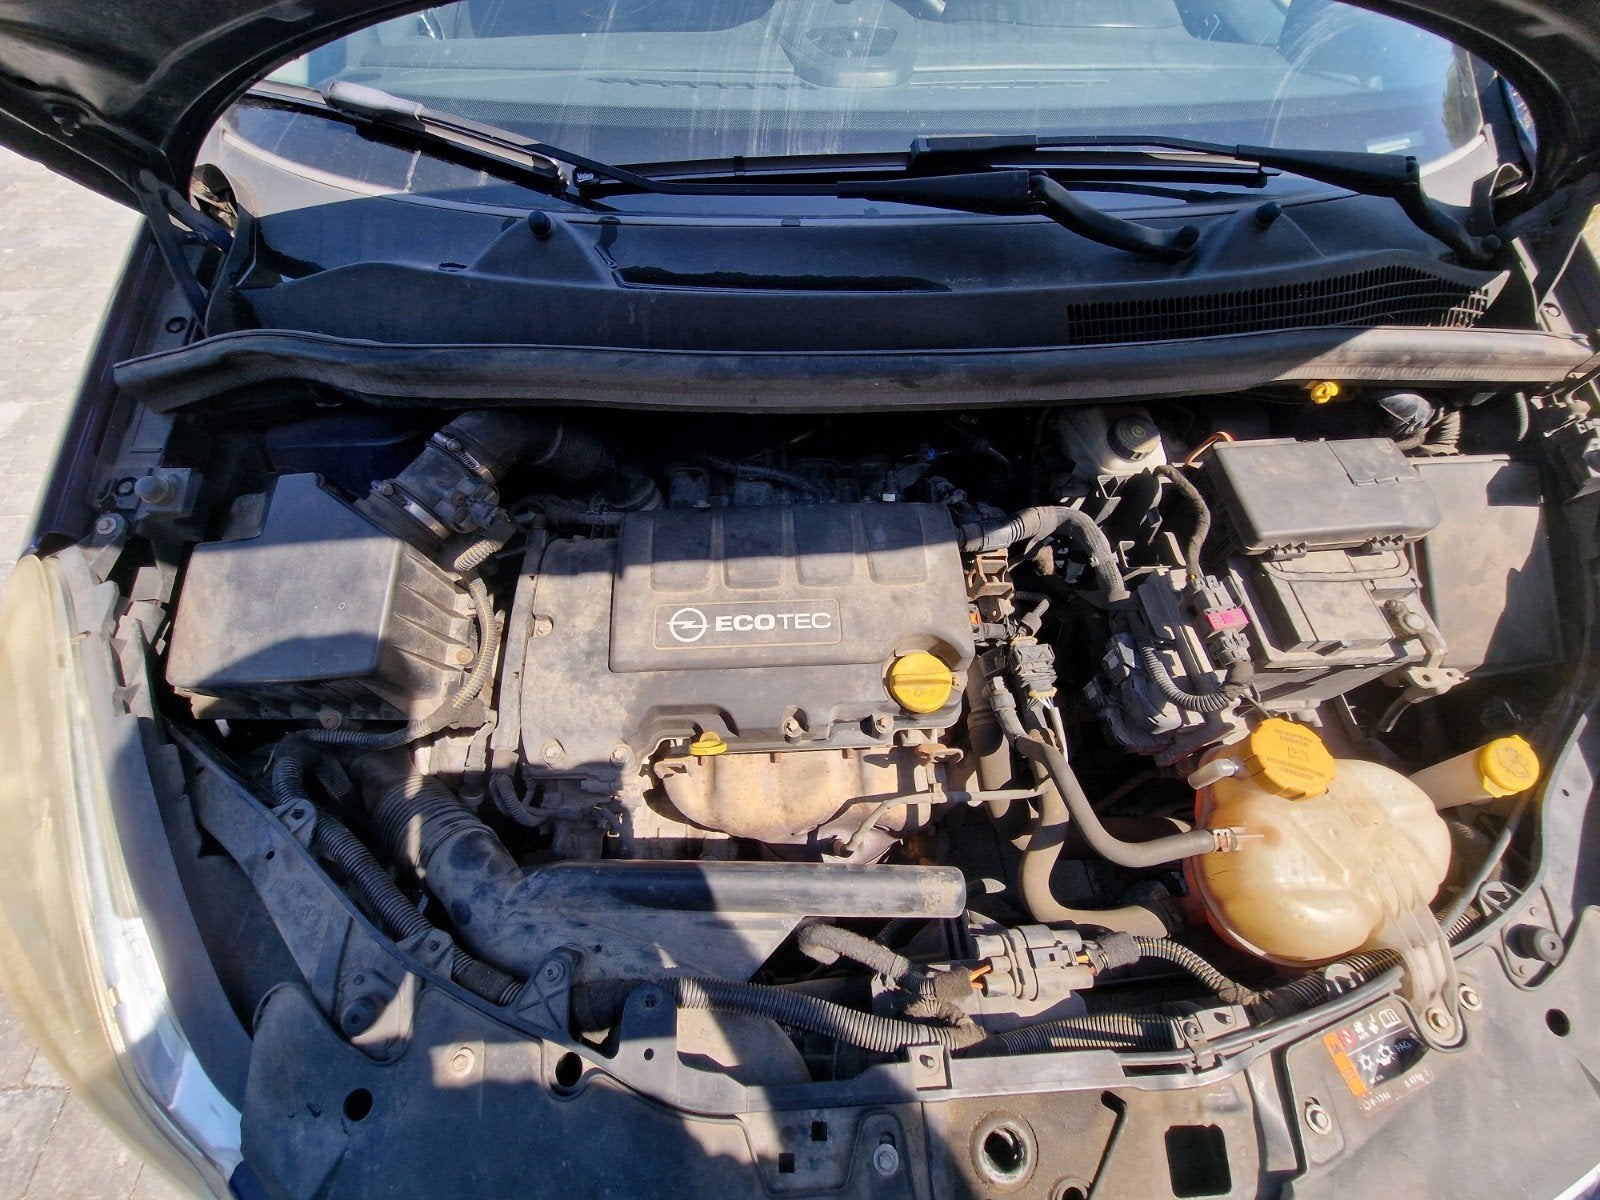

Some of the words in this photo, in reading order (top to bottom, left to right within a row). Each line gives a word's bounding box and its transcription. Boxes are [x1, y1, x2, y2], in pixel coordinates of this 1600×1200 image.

[576, 172, 594, 180] Valeo
[715, 612, 832, 632] ECOTEC
[1394, 1040, 1412, 1052] PAG
